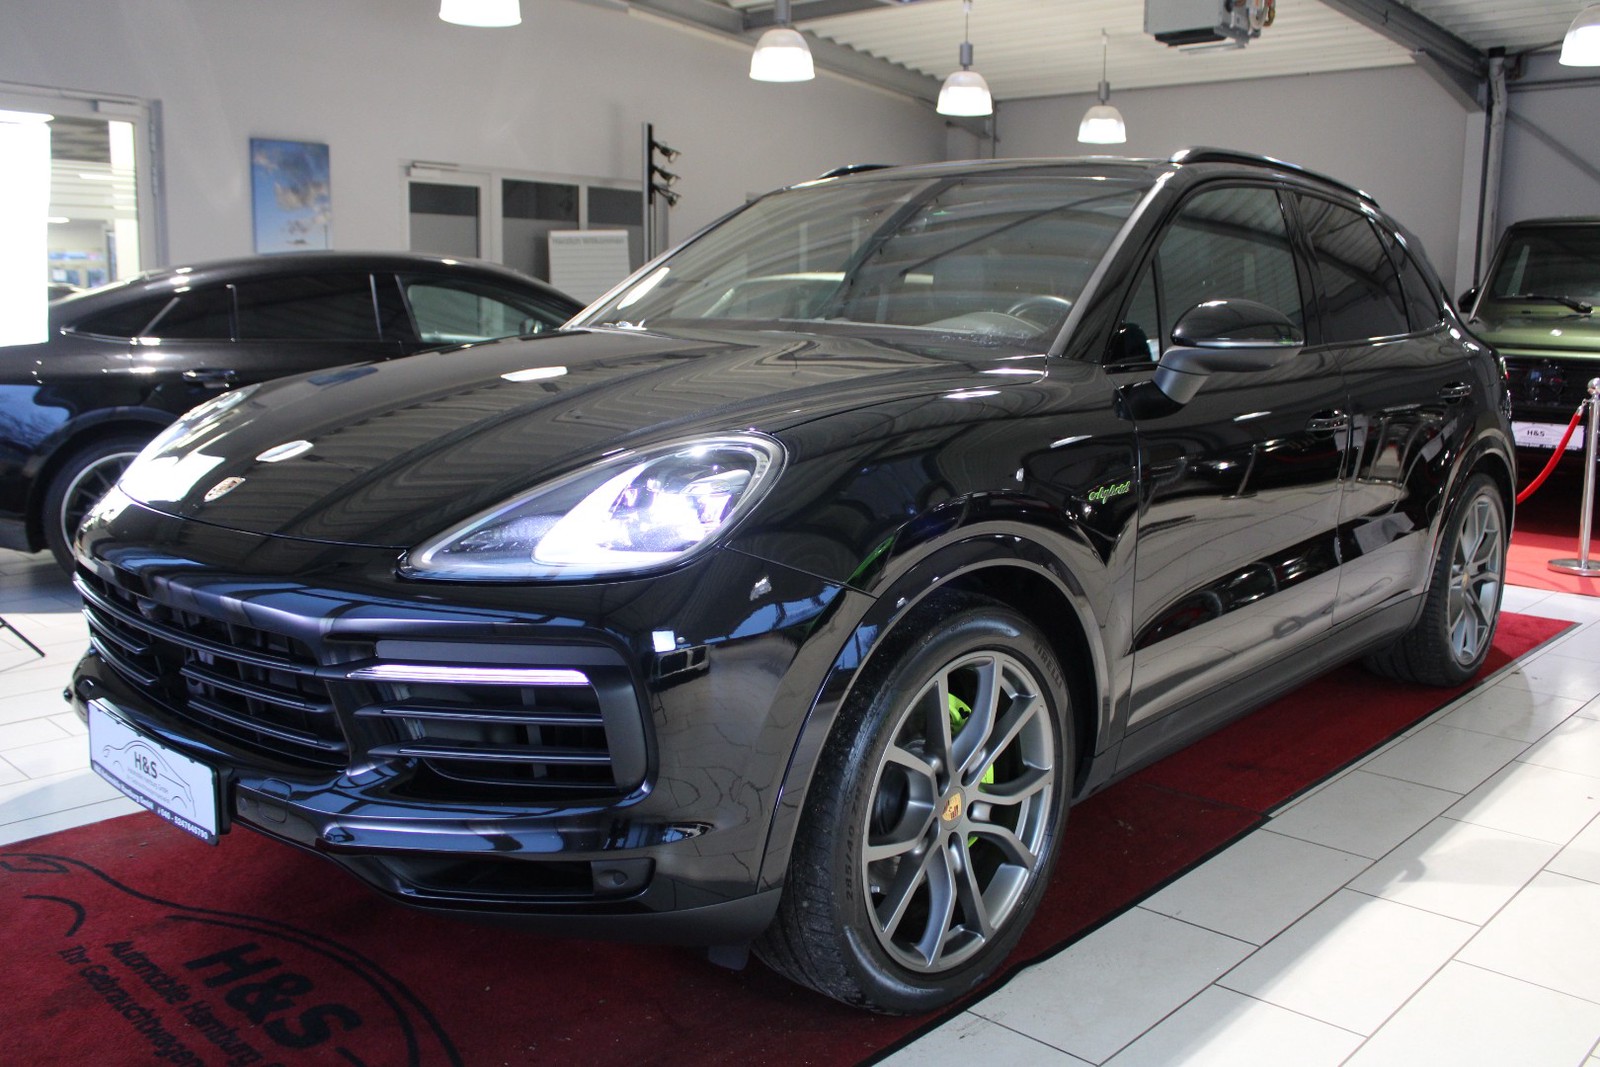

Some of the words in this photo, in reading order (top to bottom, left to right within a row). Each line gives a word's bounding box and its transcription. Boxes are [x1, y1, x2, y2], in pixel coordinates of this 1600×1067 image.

[1526, 429, 1545, 437] H&S
[134, 751, 158, 779] H&S
[58, 945, 92, 965] Ihr
[104, 941, 191, 1004] Automobile
[183, 942, 363, 1048] H&S
